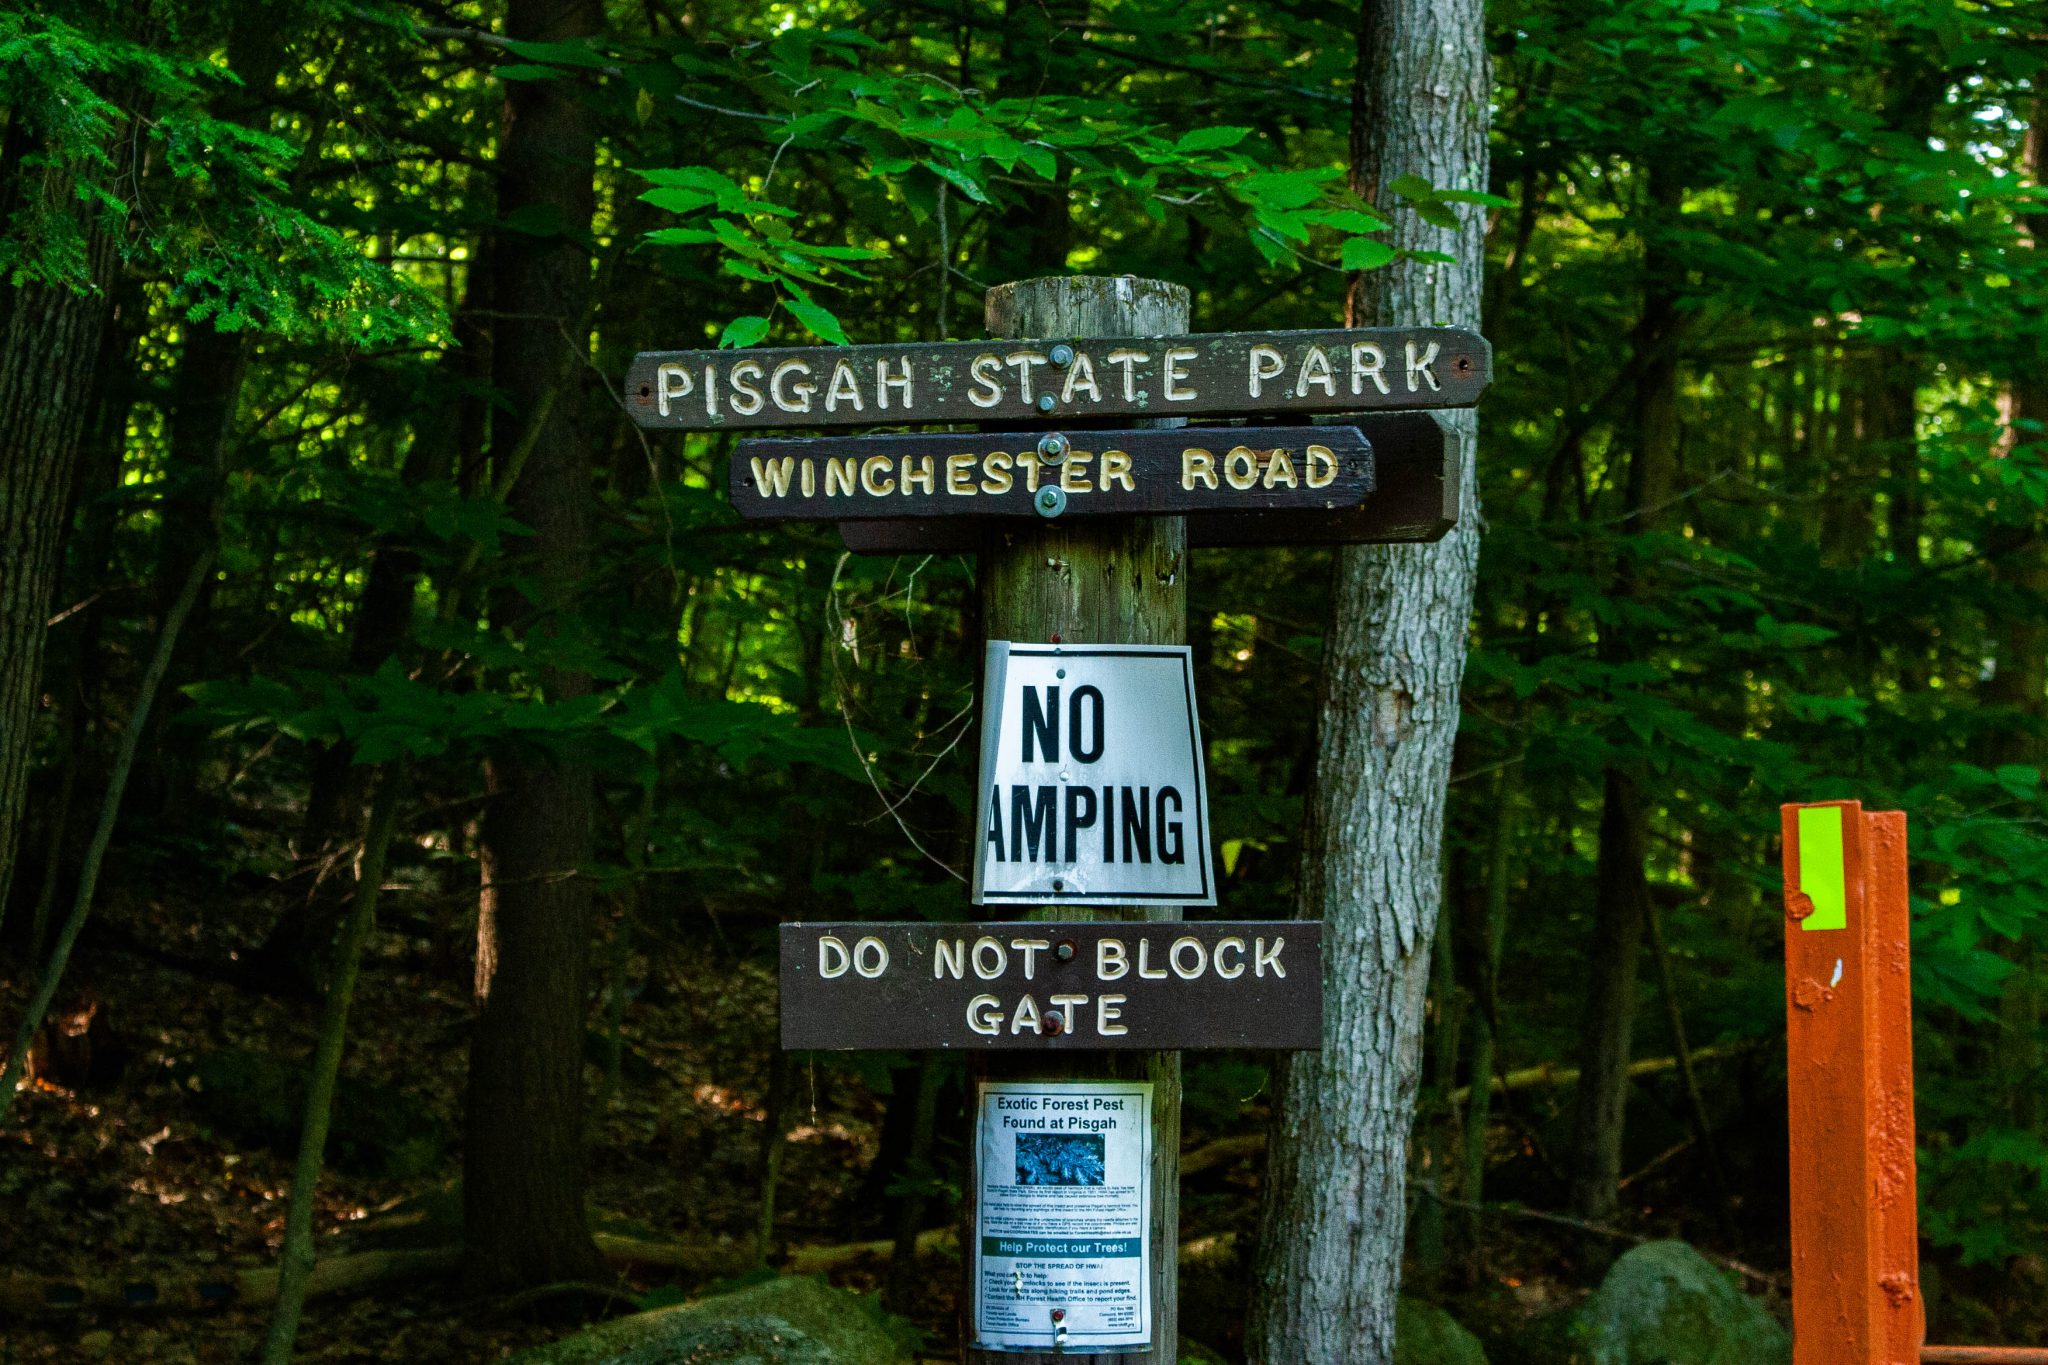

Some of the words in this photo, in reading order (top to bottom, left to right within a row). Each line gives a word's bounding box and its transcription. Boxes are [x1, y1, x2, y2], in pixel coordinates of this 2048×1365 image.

[658, 355, 914, 416] PISGAH
[968, 346, 1199, 408] STATE
[1249, 340, 1441, 398] PARK
[751, 449, 1135, 498] WINCHESTER
[1182, 445, 1338, 491] ROAD
[1022, 685, 1105, 764] NO
[819, 936, 889, 979] DO
[934, 936, 1050, 980] NOT
[1097, 937, 1287, 980] BLOCK
[966, 994, 1128, 1036] GATE
[998, 1097, 1038, 1110] Exotic
[1042, 1098, 1089, 1111] Forest
[1093, 1099, 1124, 1111] Pest
[1003, 1116, 1046, 1129] Found
[1050, 1118, 1064, 1129] at
[1068, 1117, 1117, 1132] Pisgah
[1000, 1241, 1023, 1254] Help
[1026, 1242, 1068, 1253] Protect
[1071, 1243, 1093, 1253] our
[1094, 1242, 1128, 1253] Trees!
